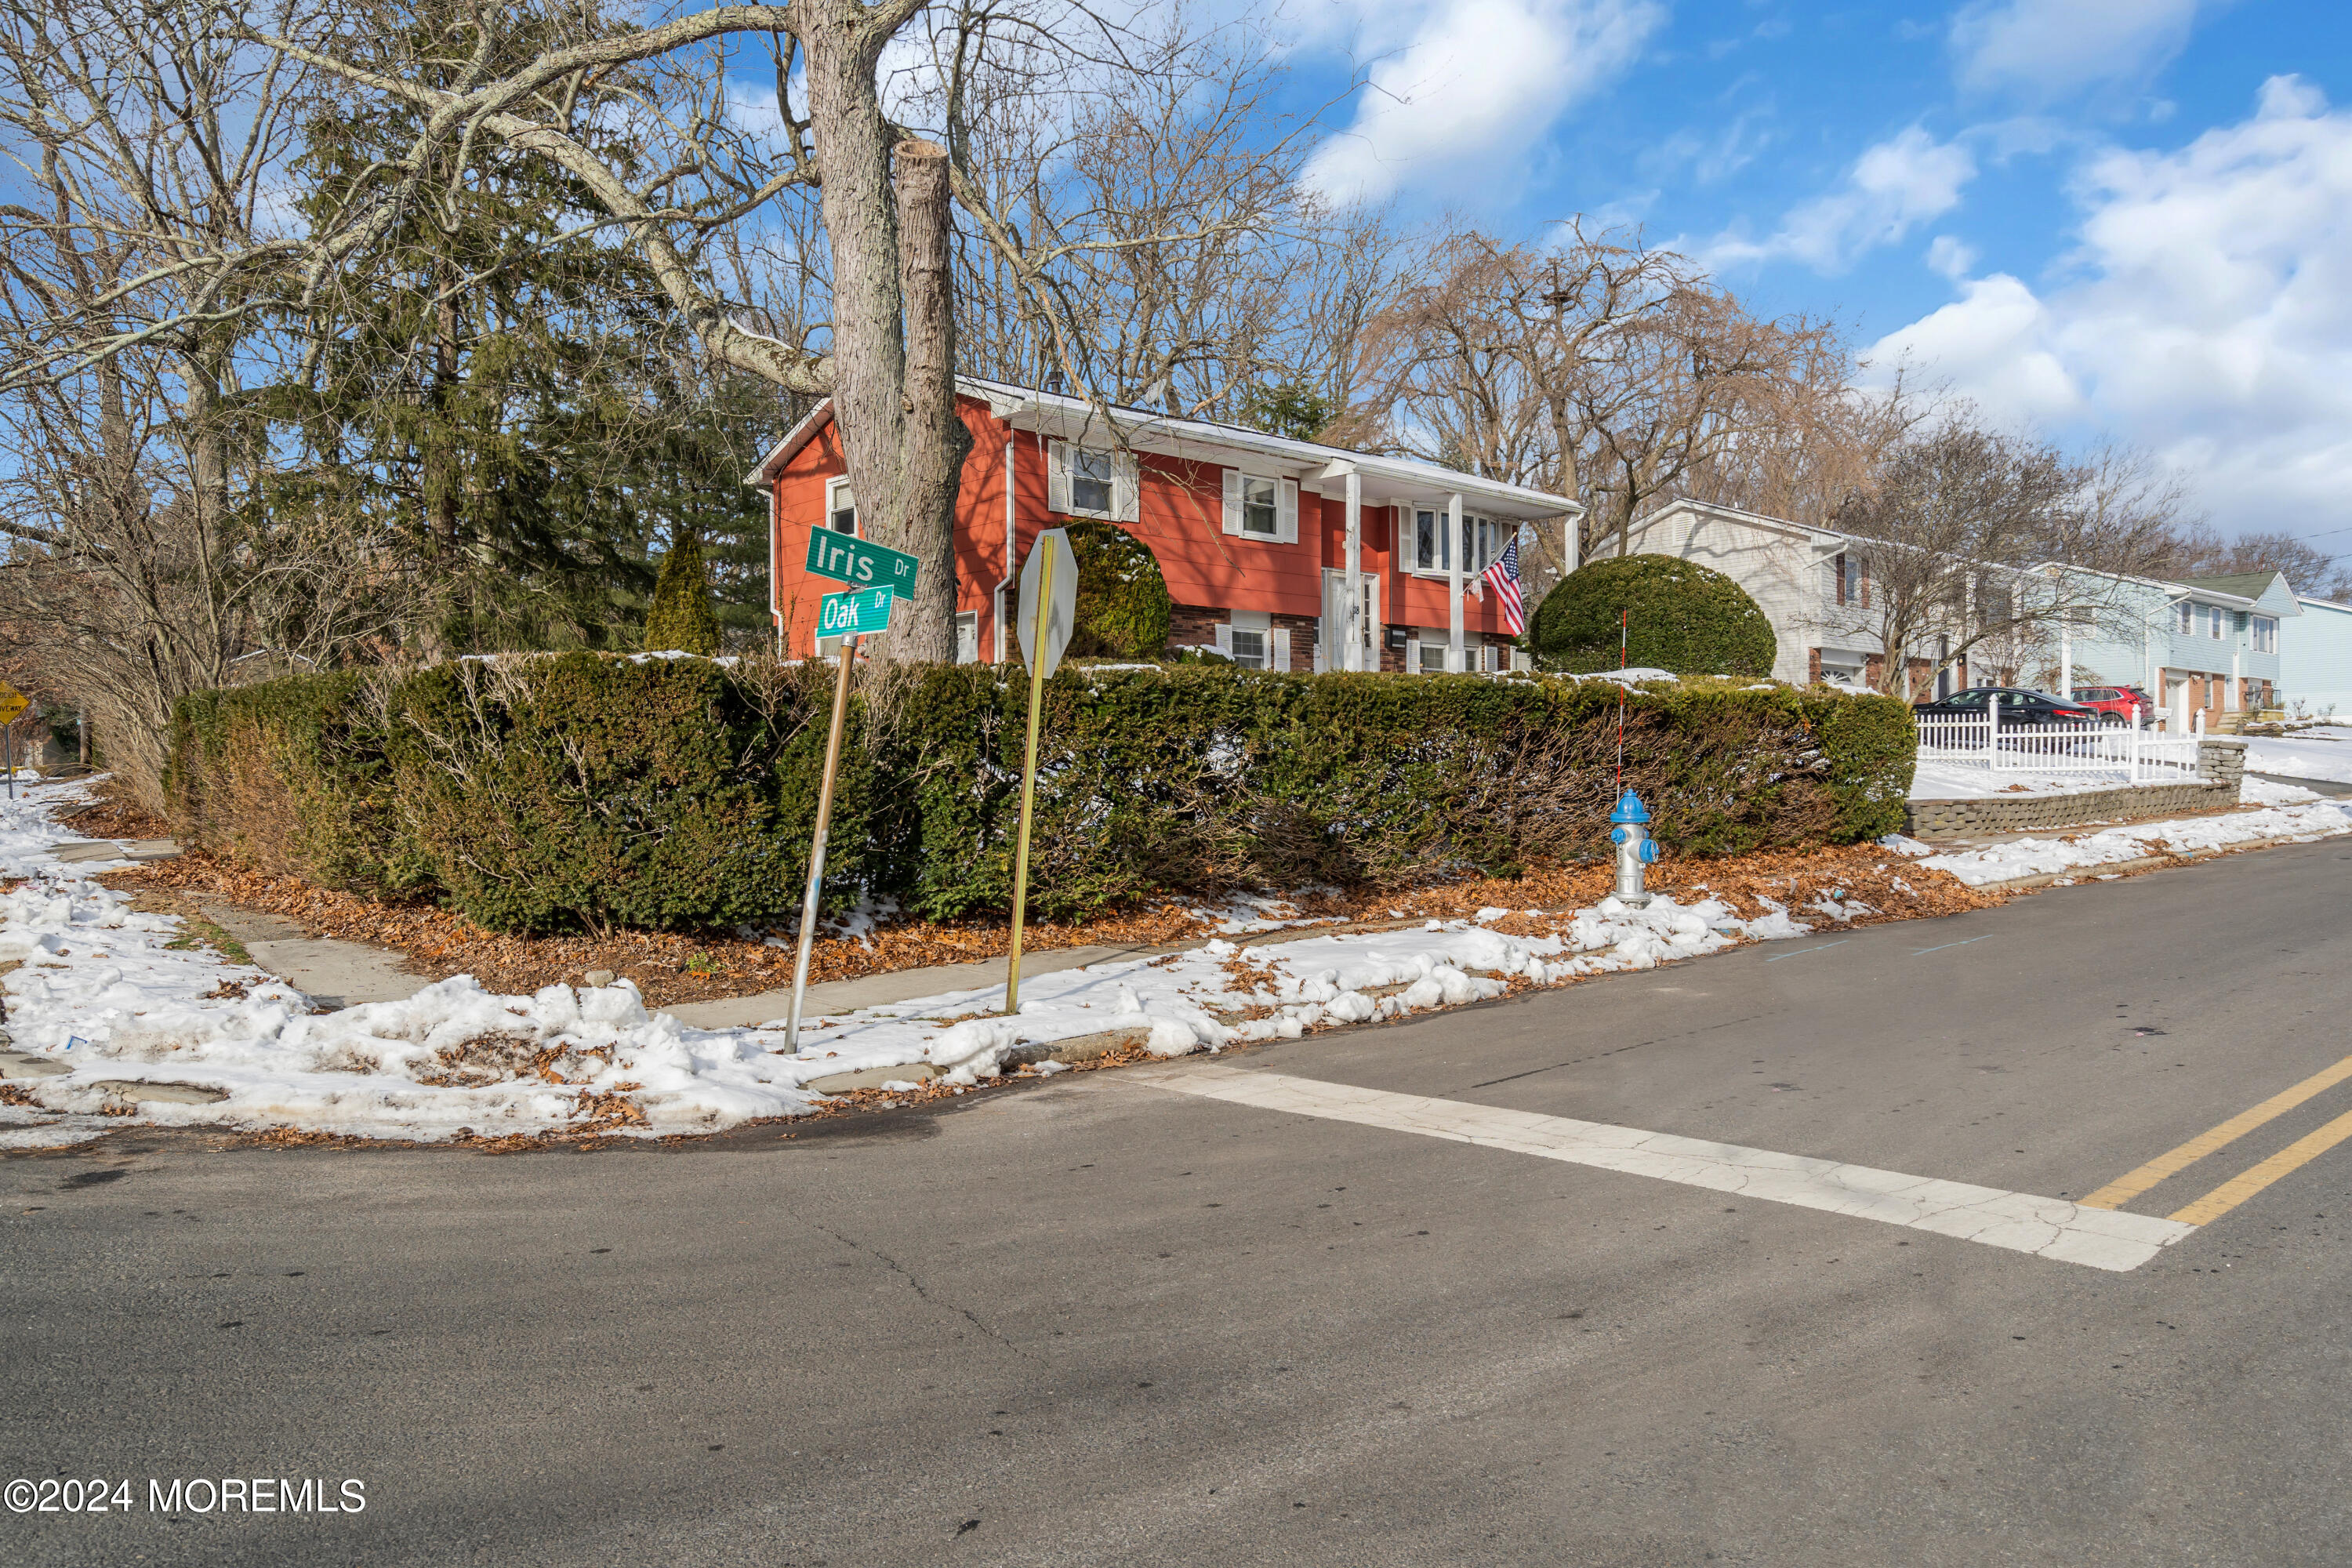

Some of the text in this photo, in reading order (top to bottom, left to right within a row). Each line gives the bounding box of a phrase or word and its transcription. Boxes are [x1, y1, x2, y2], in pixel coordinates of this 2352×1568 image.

[817, 535, 909, 581] Iris Dr
[824, 591, 886, 630] Oak Dr
